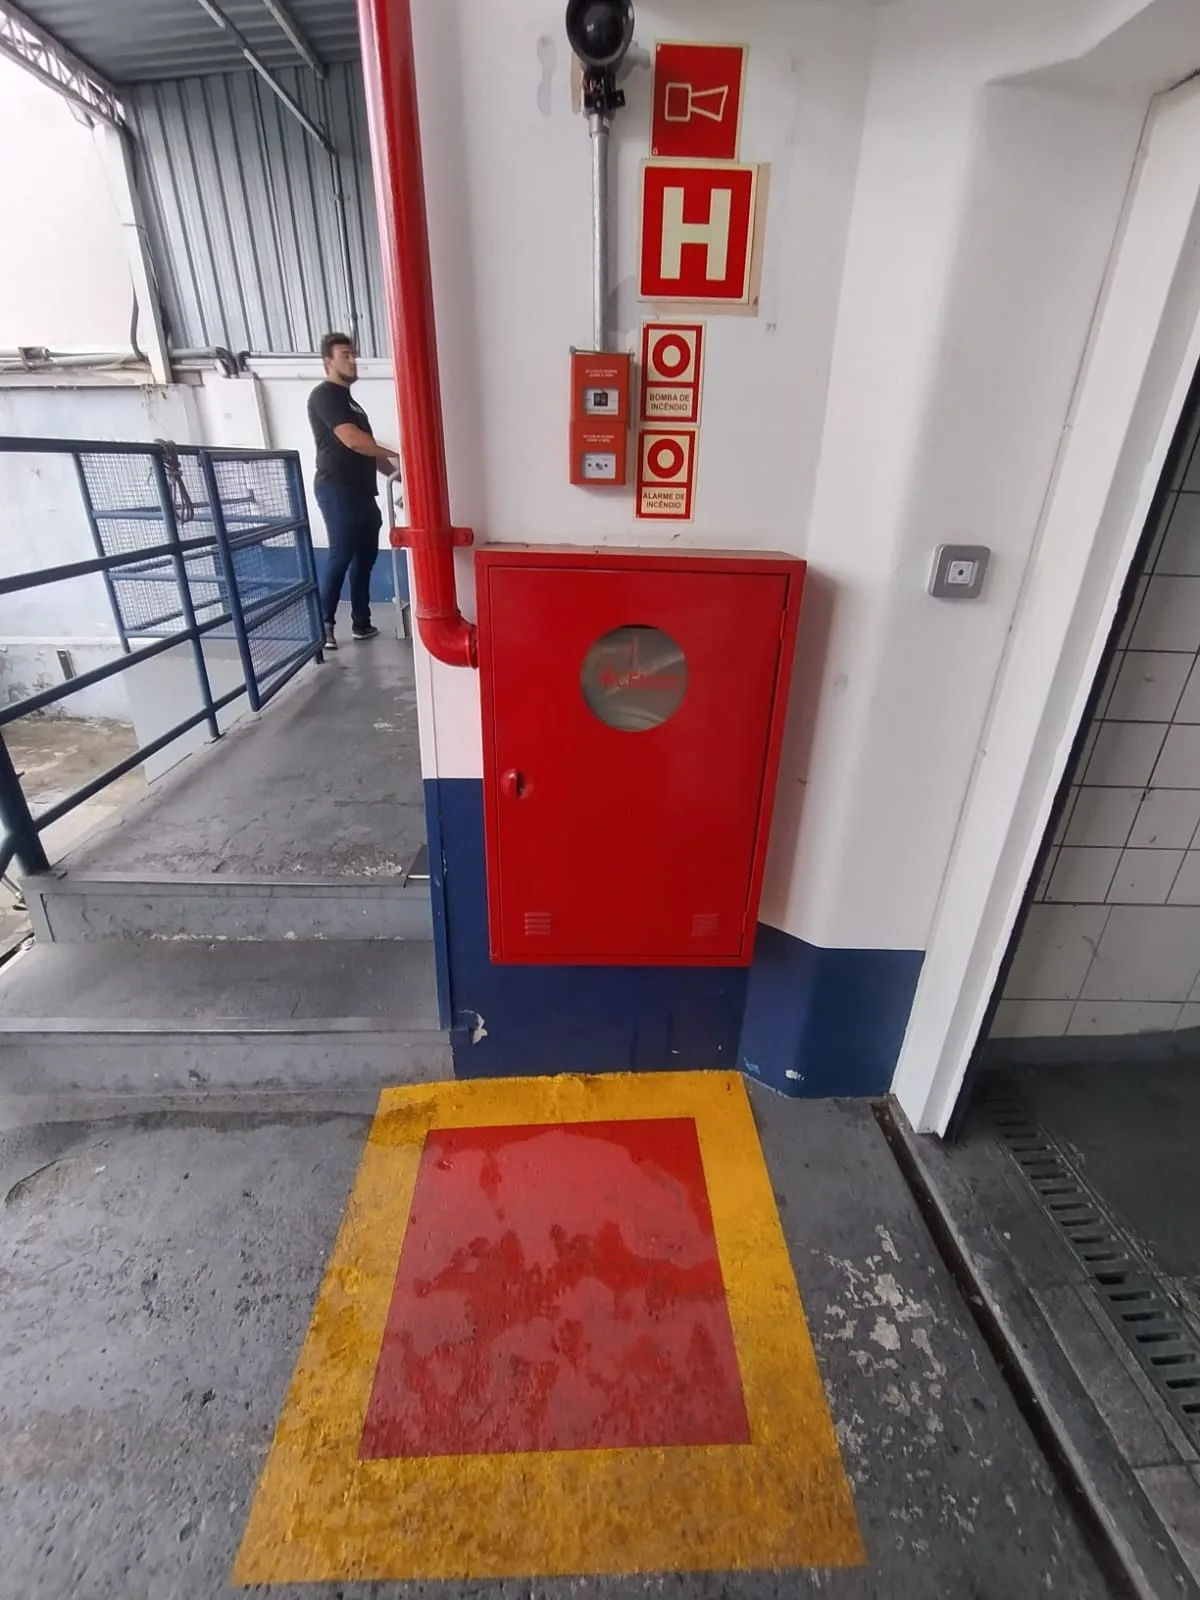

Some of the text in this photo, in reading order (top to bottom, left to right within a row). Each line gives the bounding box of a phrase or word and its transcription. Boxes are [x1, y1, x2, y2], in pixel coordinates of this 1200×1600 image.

[660, 186, 732, 281] H
[649, 393, 690, 402] BOMBA DE
[650, 402, 688, 412] INCÊNDIO
[646, 501, 682, 509] INCÊNDIO
